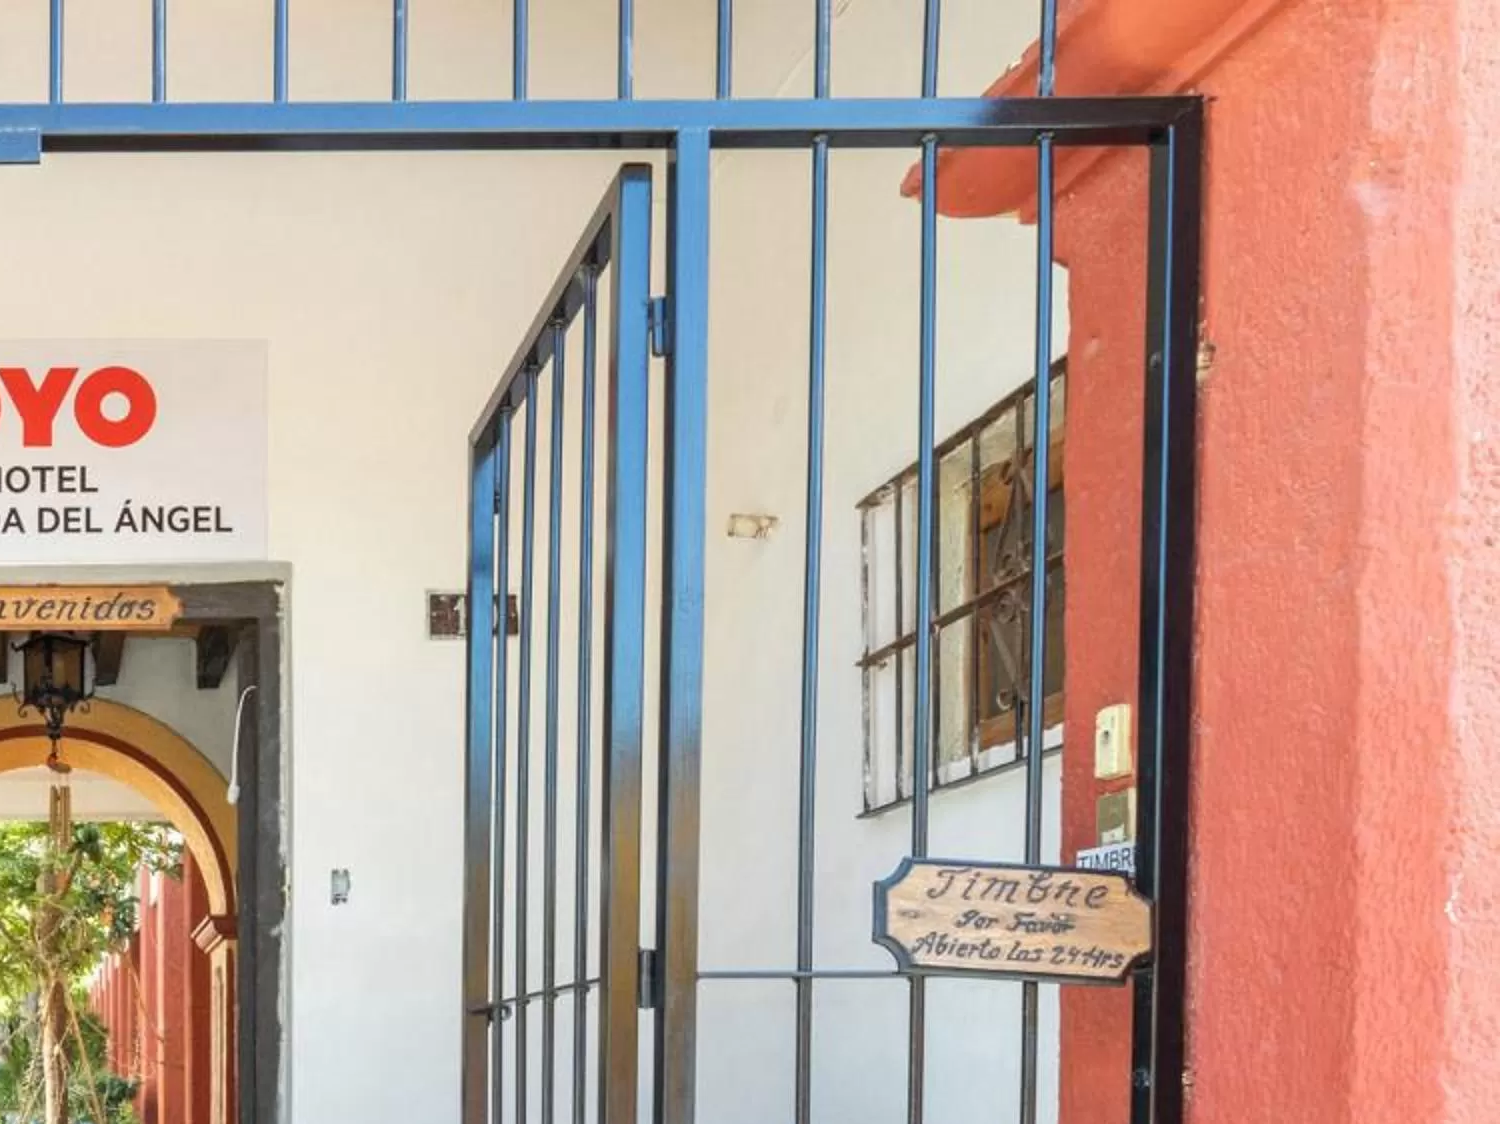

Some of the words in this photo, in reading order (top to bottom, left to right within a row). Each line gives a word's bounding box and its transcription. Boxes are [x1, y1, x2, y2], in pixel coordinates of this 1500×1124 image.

[37, 506, 103, 534] DEL
[114, 499, 233, 533] ÁNGEL
[1078, 847, 1136, 869] TIMBR
[926, 867, 1109, 909] Timbre
[954, 908, 999, 930] Por
[912, 931, 1001, 960] Abierto
